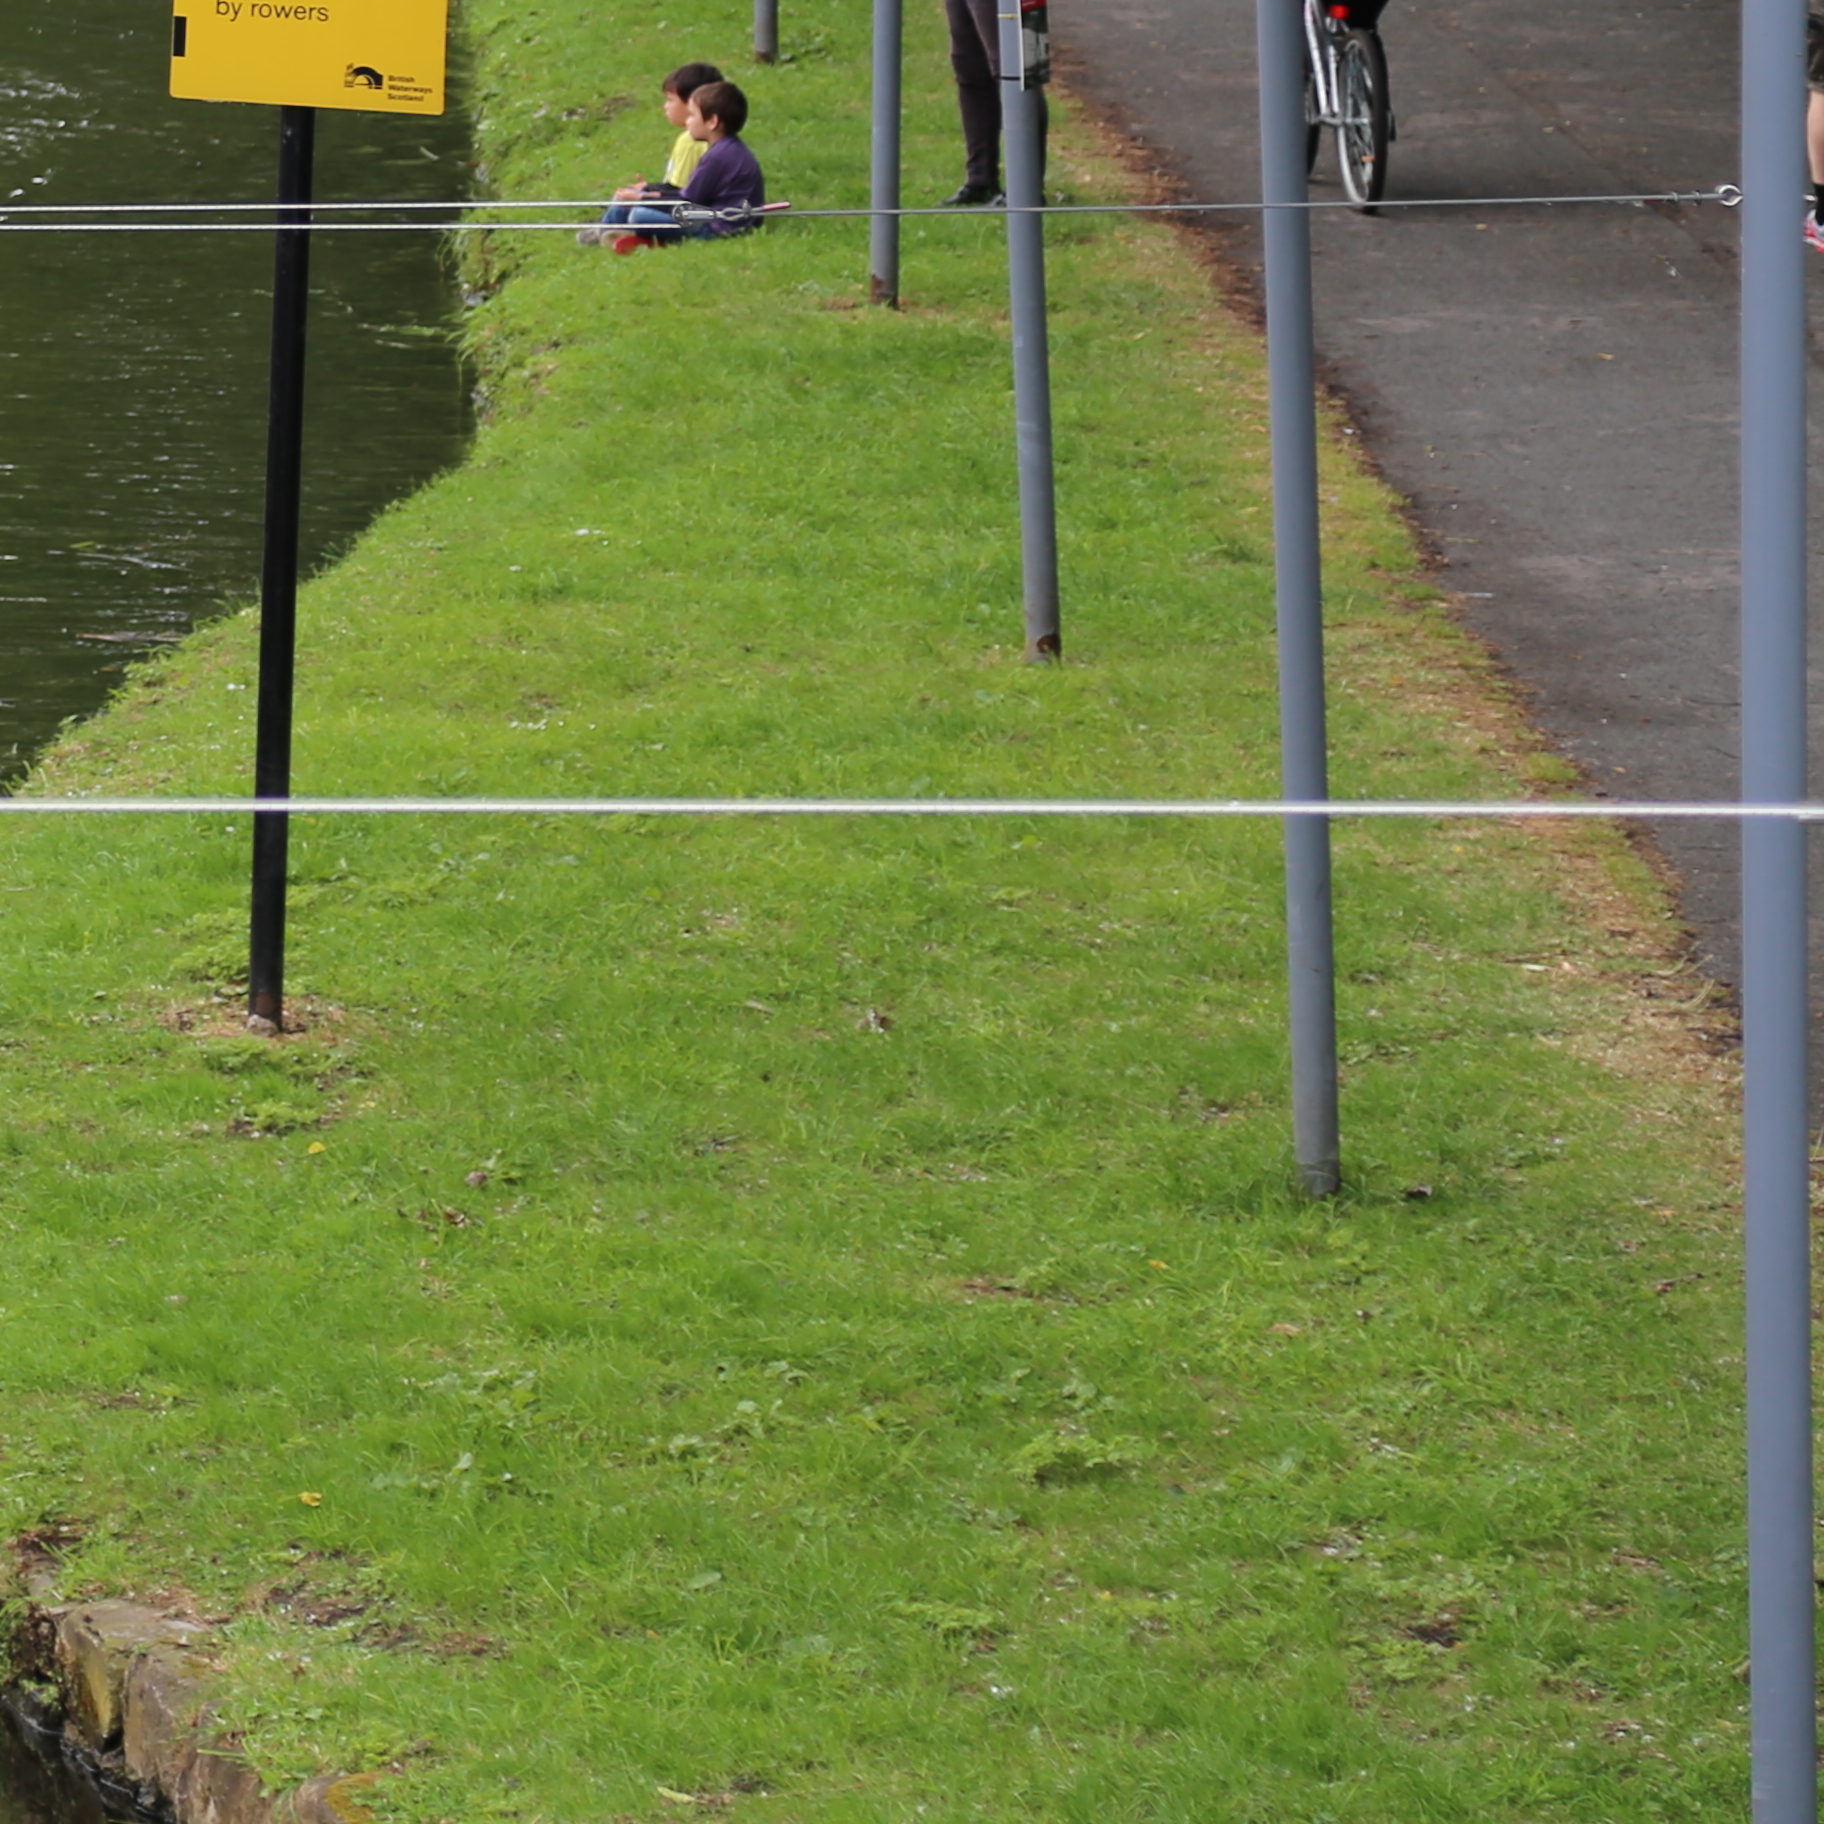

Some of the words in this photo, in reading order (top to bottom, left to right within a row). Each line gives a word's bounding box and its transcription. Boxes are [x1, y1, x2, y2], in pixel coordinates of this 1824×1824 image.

[251, 2, 329, 22] rowers
[388, 74, 415, 83] British
[387, 84, 433, 94] Waterways
[387, 93, 424, 102] Scotland
